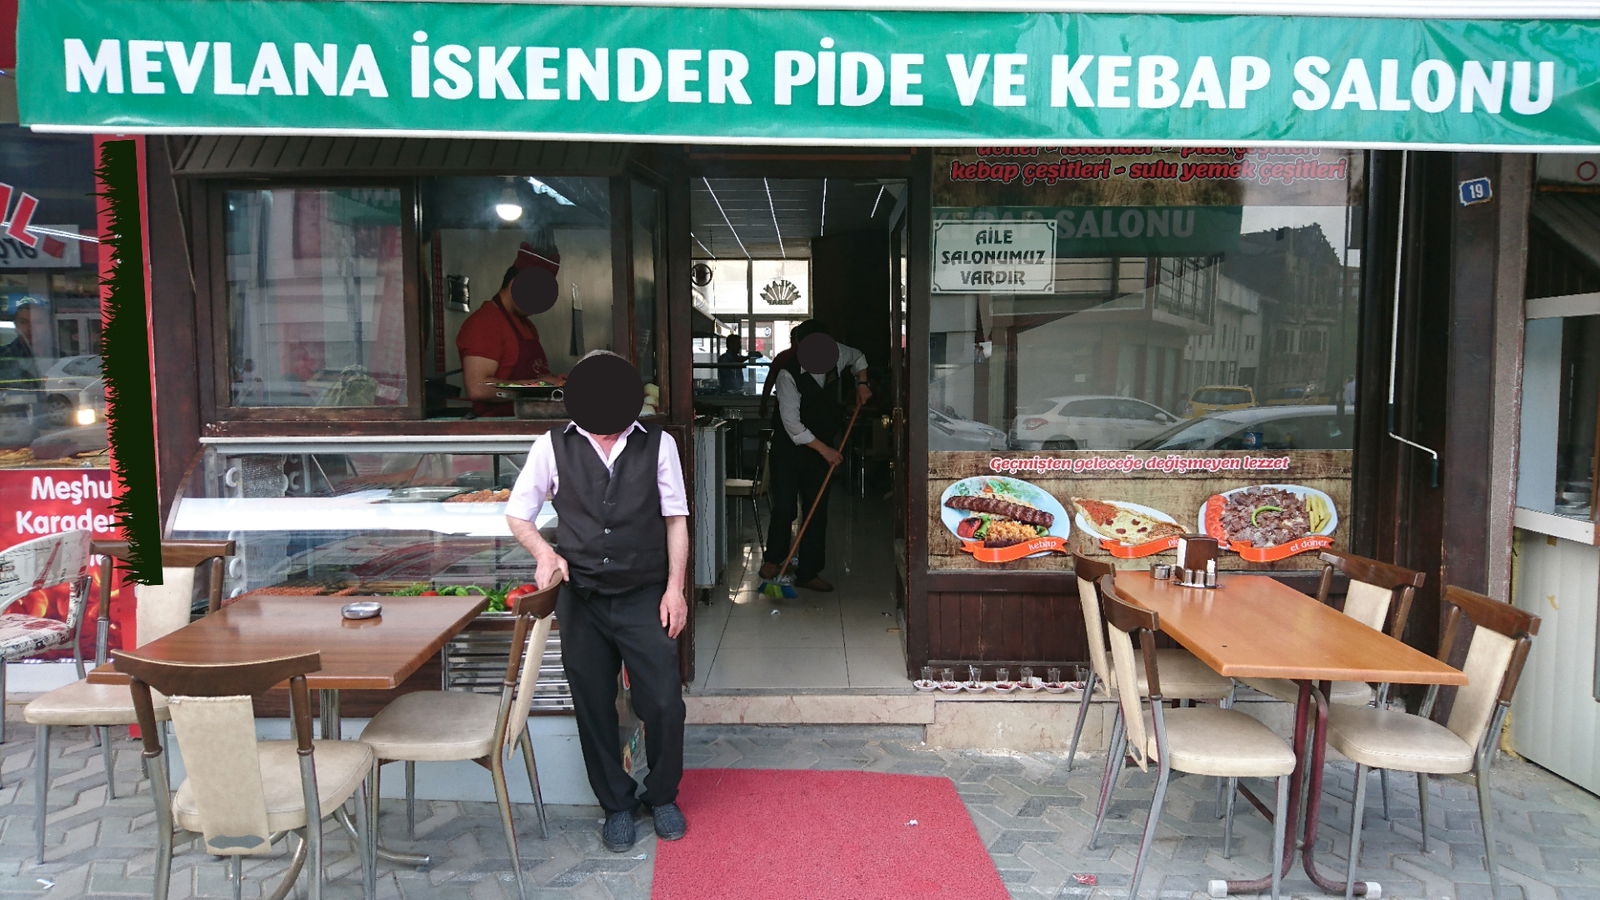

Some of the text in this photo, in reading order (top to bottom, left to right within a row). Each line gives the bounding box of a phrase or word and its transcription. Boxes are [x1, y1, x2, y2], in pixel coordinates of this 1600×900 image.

[63, 30, 1555, 115] MEVLANA İSKENDER PİDE VE KEBAP SALONU
[950, 160, 1020, 183] kebap
[1022, 157, 1112, 185] çeşitleri
[1129, 159, 1178, 179] sulu
[1178, 160, 1256, 182] yemek
[1258, 157, 1348, 185] çeşitleri
[1469, 183, 1484, 198] 19
[975, 226, 1013, 245] AİLE
[941, 250, 1046, 265] SALONUMUZ
[960, 270, 1026, 286] VARDIR
[989, 455, 1290, 473] Geçmişten geleceğe değişmeyen lezzet
